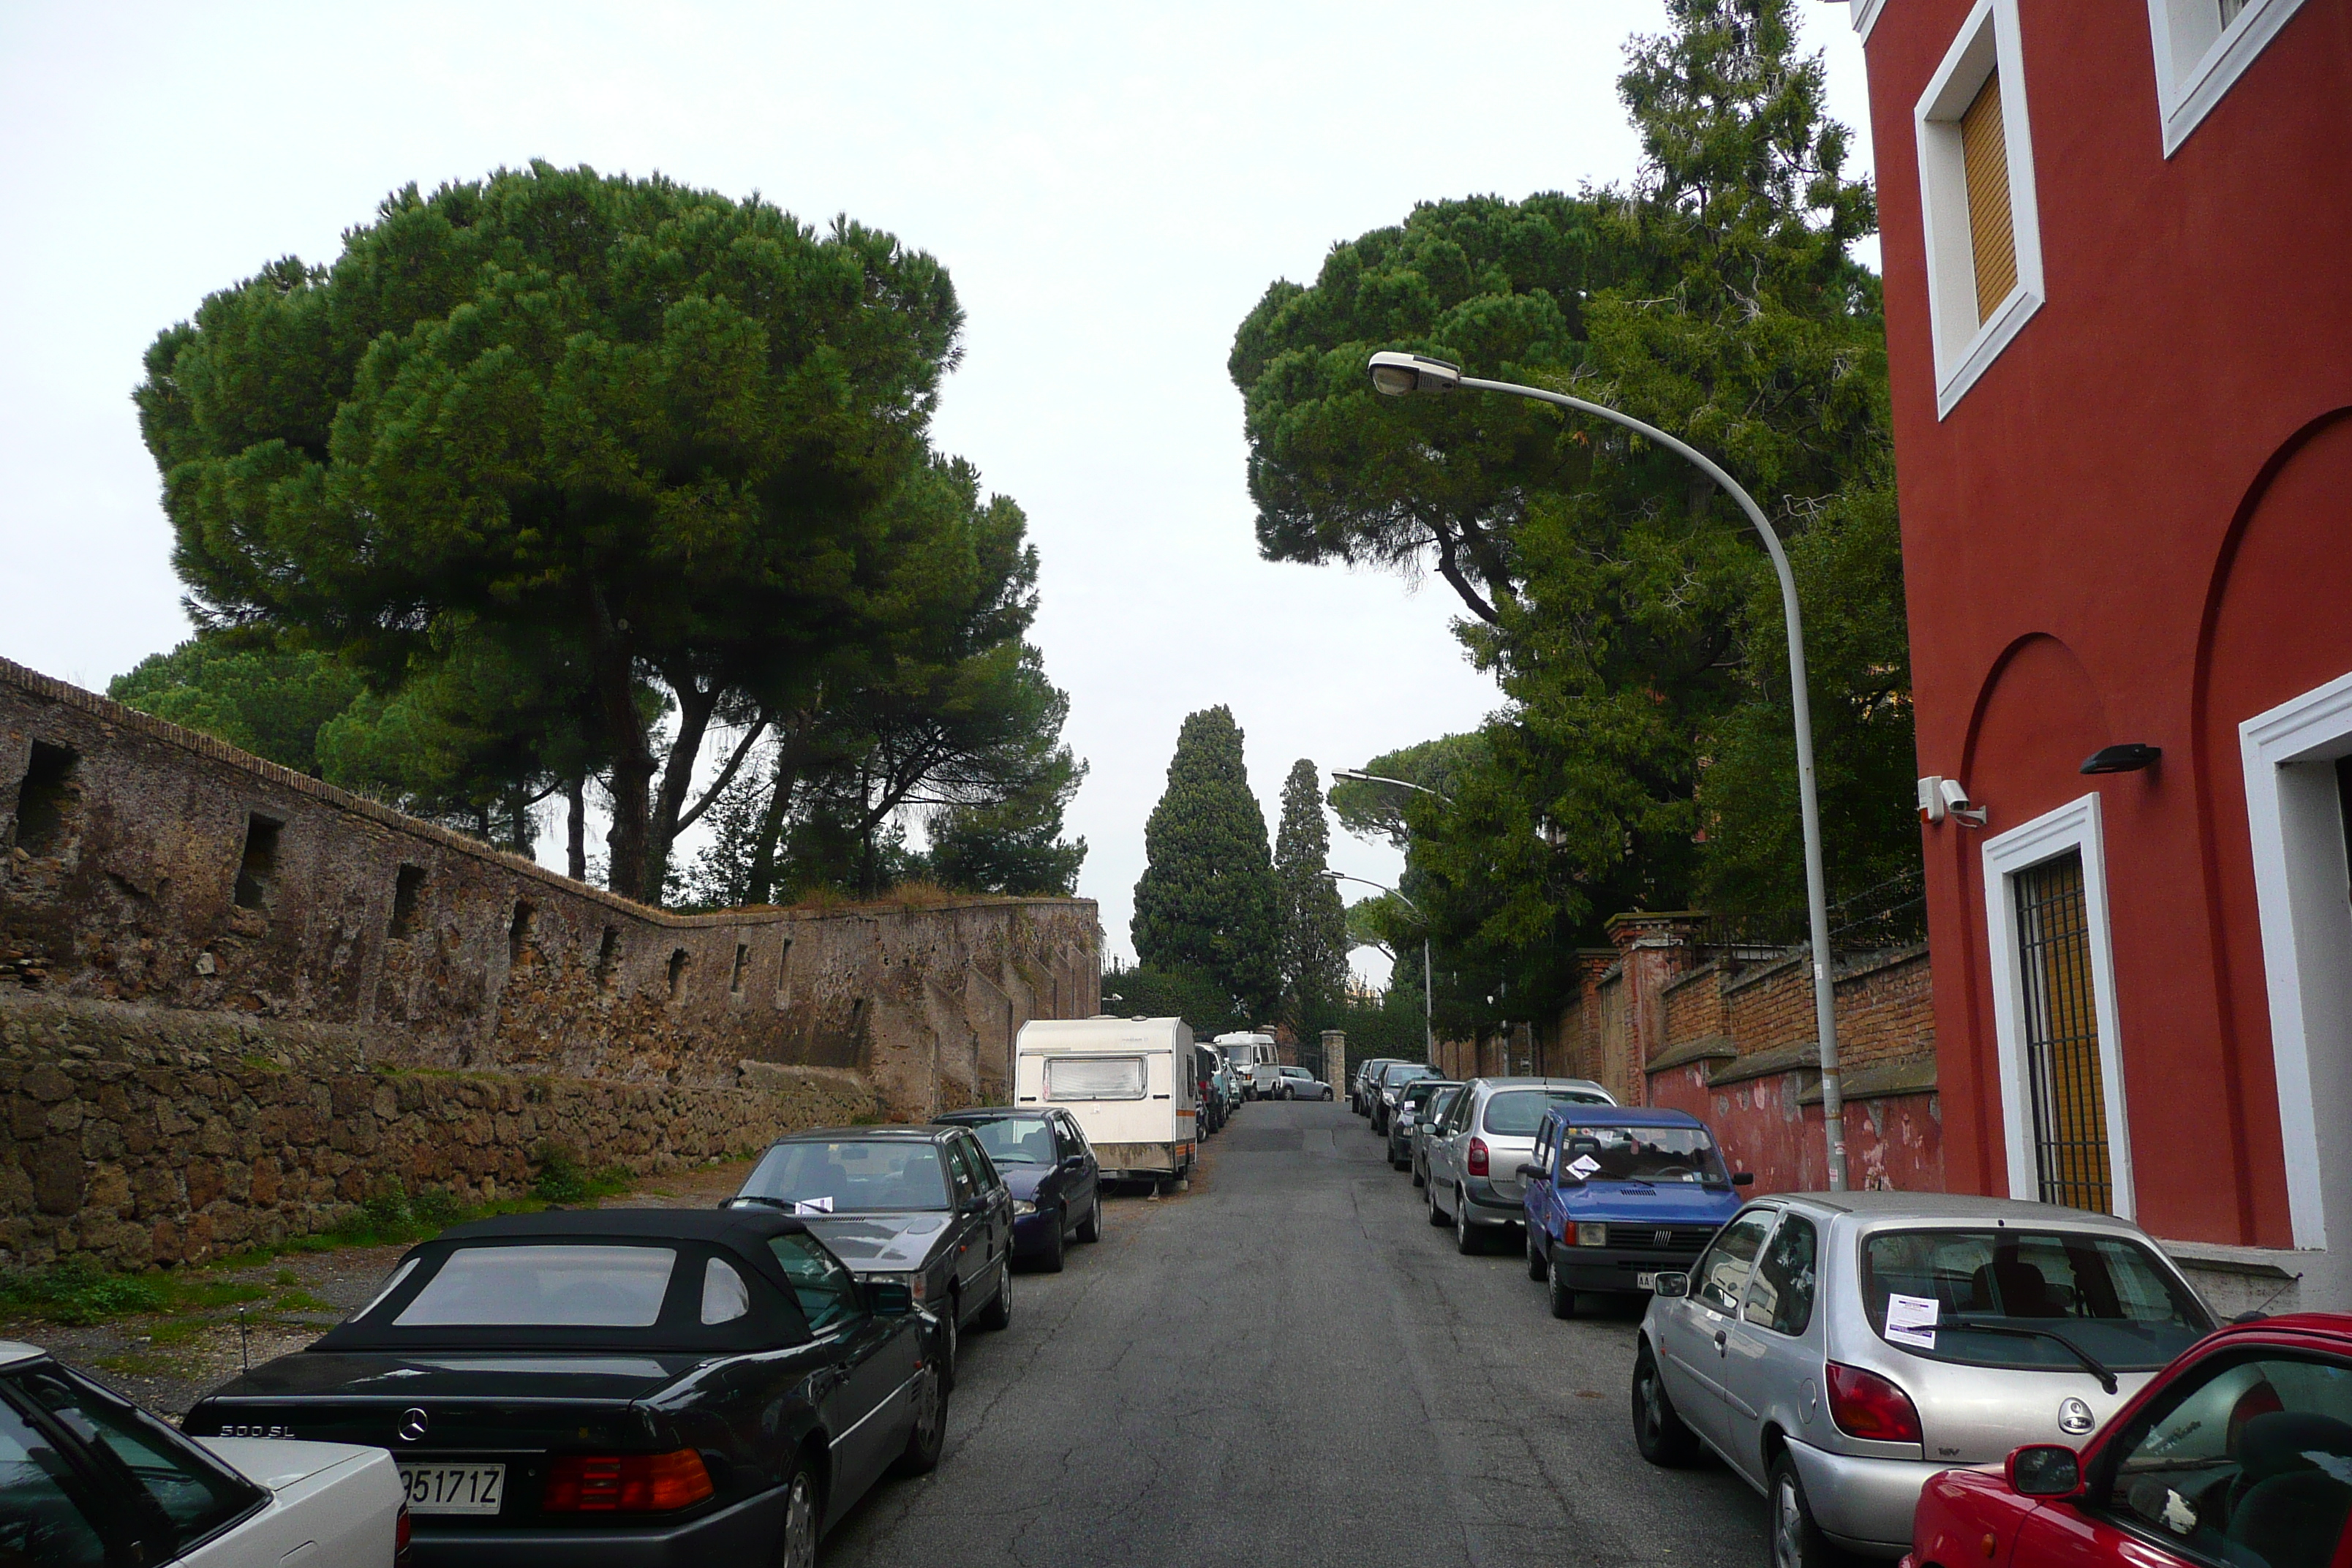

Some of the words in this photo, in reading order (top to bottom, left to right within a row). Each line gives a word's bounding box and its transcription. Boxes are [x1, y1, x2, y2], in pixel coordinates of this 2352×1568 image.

[220, 1425, 263, 1436] 500
[268, 1426, 295, 1437] SL
[400, 1470, 500, 1503] 95171Z
